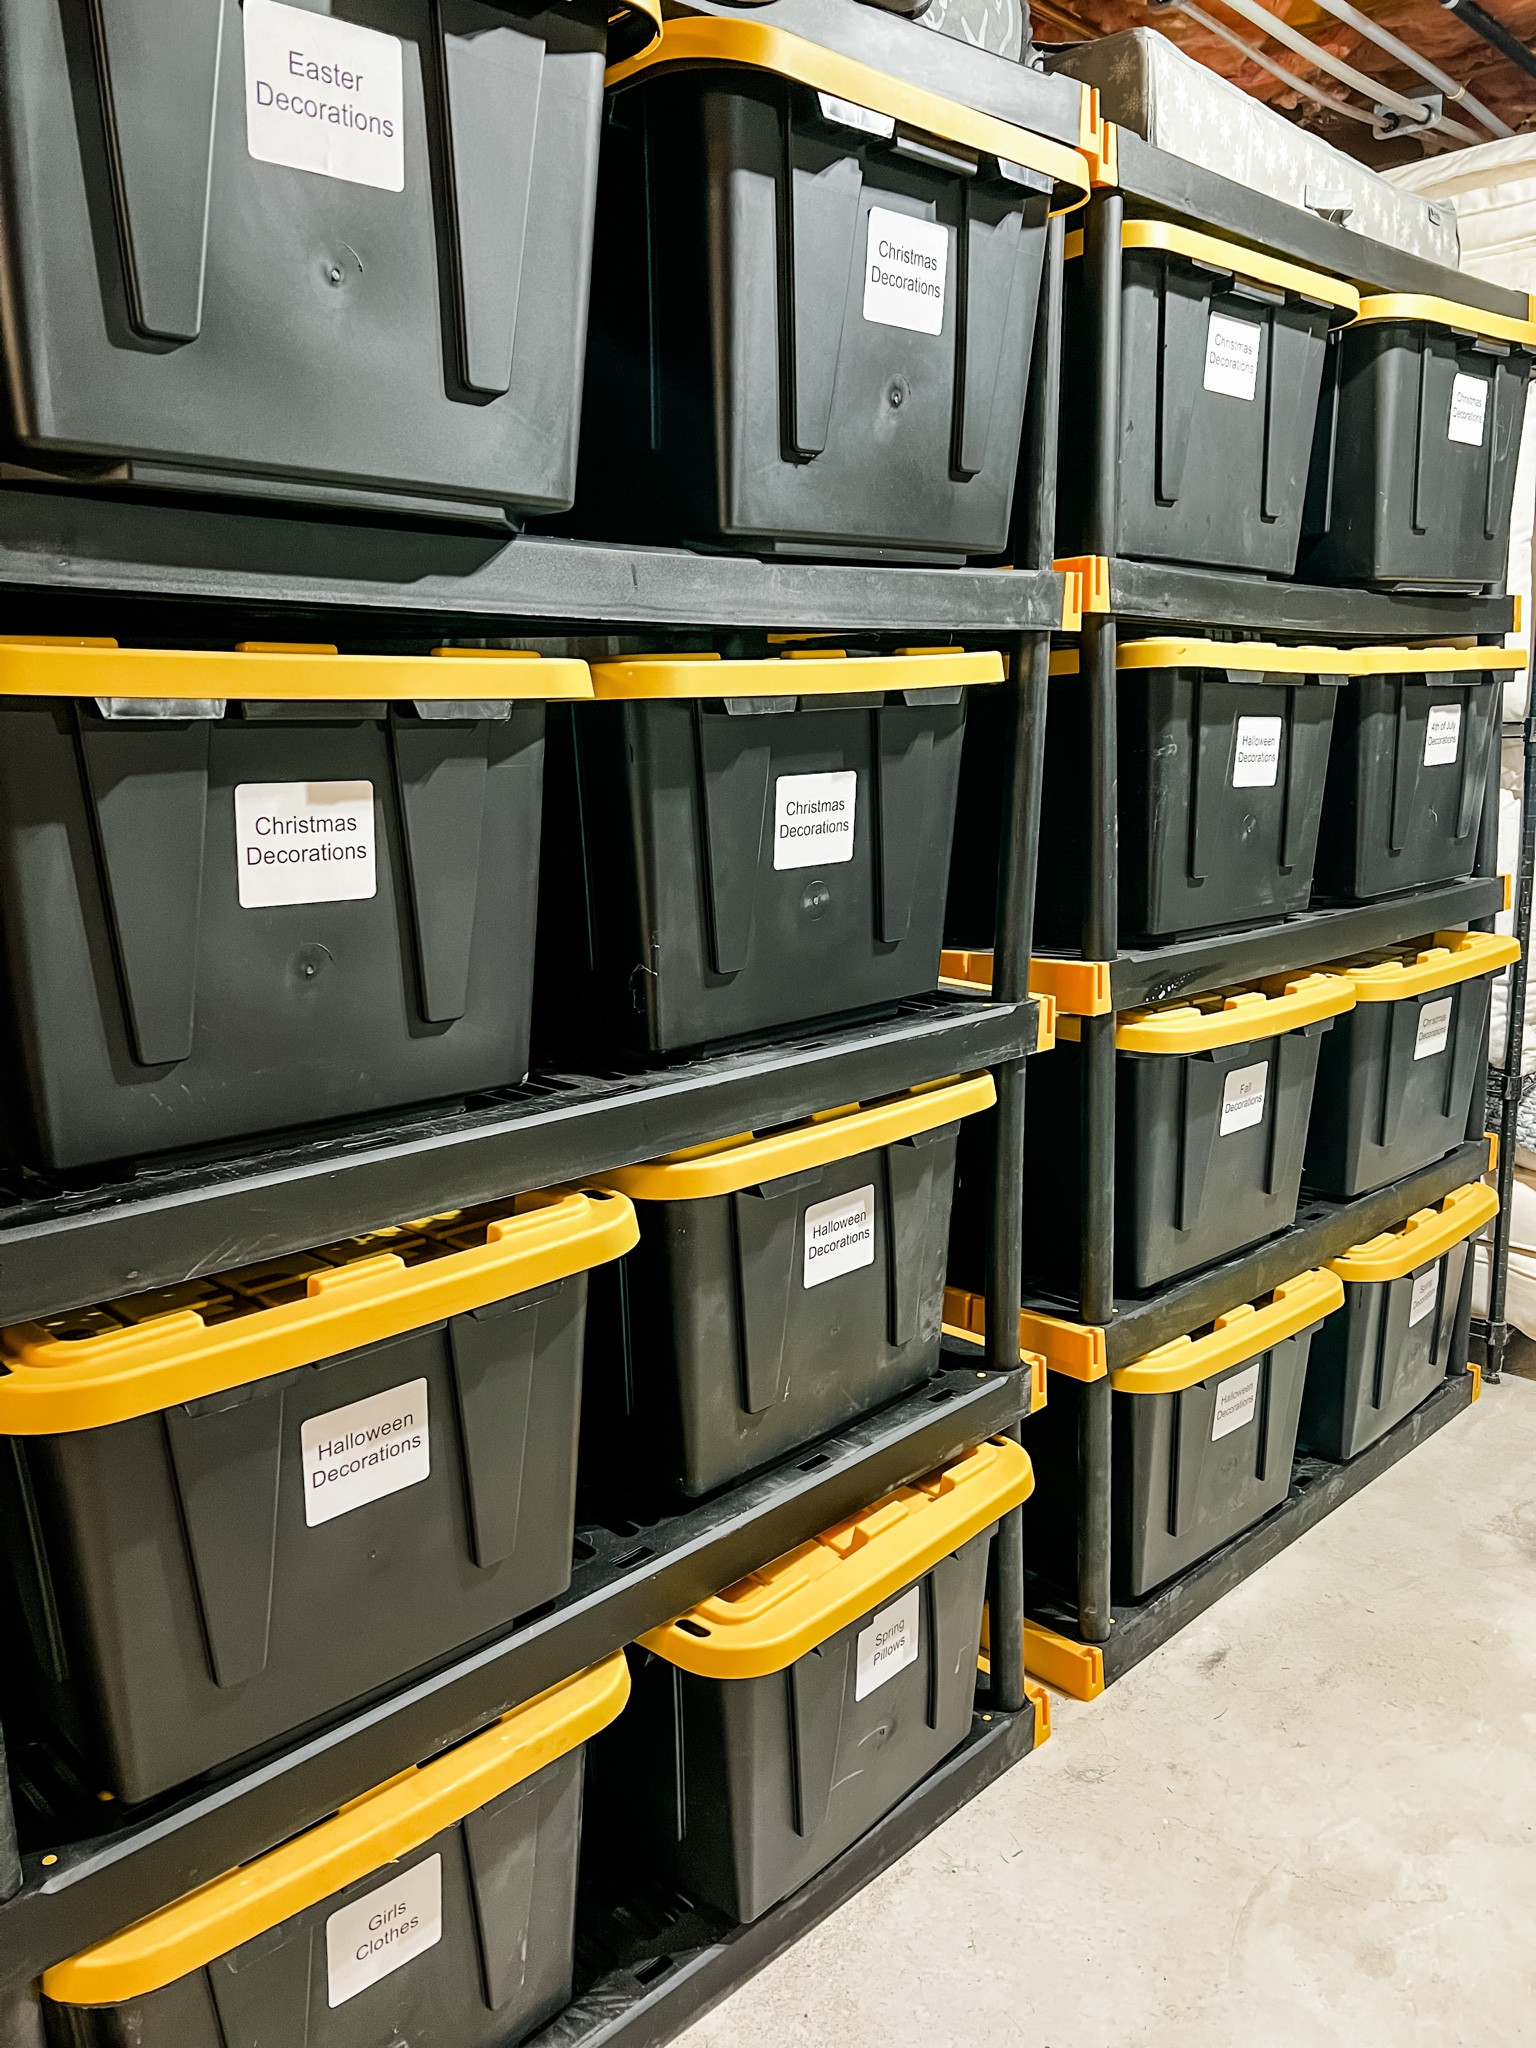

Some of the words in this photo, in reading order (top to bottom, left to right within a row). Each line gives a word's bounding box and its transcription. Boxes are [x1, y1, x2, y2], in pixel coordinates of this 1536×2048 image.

[288, 50, 364, 93] Easter
[255, 80, 395, 140] Decorations
[877, 239, 938, 272] Christmas
[870, 266, 942, 299] Decorations
[1214, 332, 1253, 356] Christmas
[1209, 351, 1254, 375] Decorations
[1456, 391, 1482, 408] Christmas
[1452, 407, 1483, 424] Decorations
[1242, 735, 1276, 747] Halloween
[1427, 735, 1456, 746] Decorations
[1238, 752, 1276, 764] Decorations
[786, 799, 846, 816] Christmas
[254, 813, 358, 837] Christmas
[779, 820, 849, 839] Decorations
[246, 841, 368, 868] Decorations
[1422, 1014, 1447, 1028] Christmas
[1418, 1026, 1447, 1042] Decorations
[1239, 1081, 1252, 1095] Fall
[1224, 1094, 1263, 1114] Decorations
[812, 1210, 867, 1239] Halloween
[808, 1227, 870, 1260] Decorations
[1220, 1383, 1254, 1406] Halloween
[1216, 1395, 1254, 1421] Decorations
[317, 1413, 414, 1461] Halloween
[311, 1435, 422, 1490] Decorations
[874, 1617, 906, 1649] Spring
[872, 1636, 906, 1667] Pillows
[367, 1900, 407, 1932] Girls
[355, 1914, 419, 1963] Clothes
